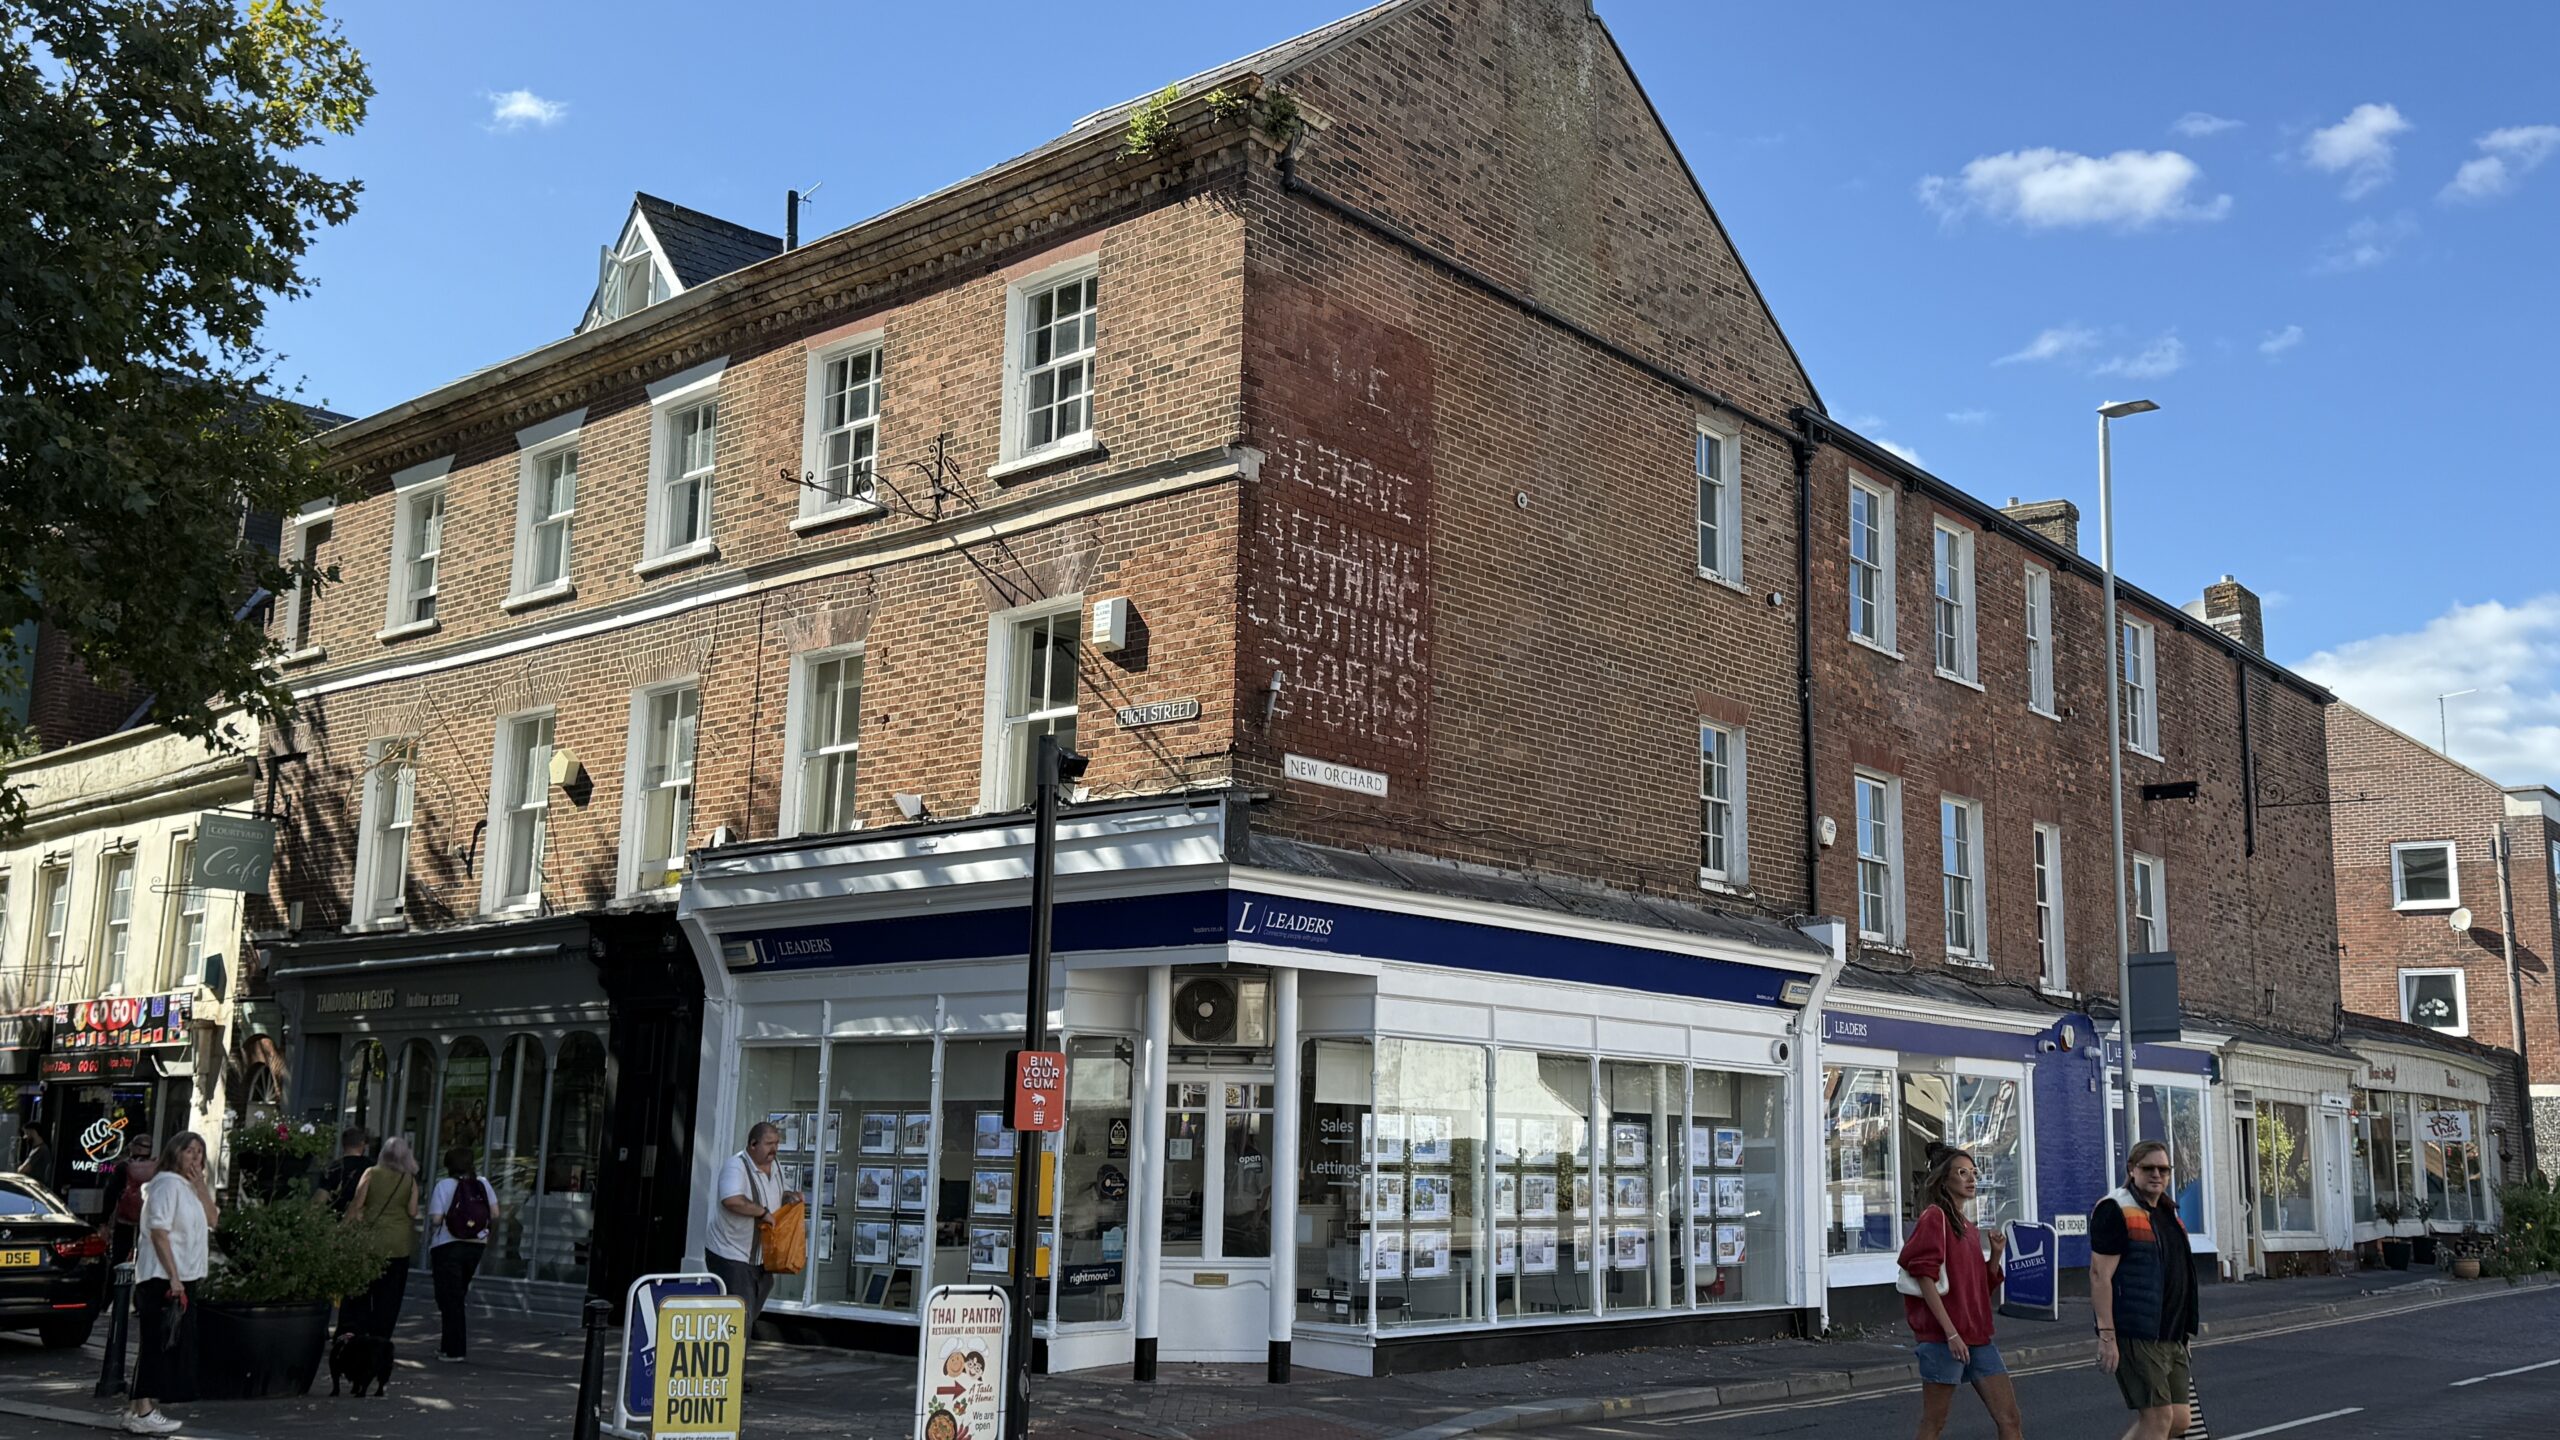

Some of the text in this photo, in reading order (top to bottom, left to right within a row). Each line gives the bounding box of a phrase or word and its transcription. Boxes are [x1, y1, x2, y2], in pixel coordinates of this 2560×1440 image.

[1120, 702, 1192, 725] HIGH STREET
[1290, 759, 1383, 791] NEW ORCHARD
[211, 826, 263, 840] COURTYARD
[1235, 901, 1334, 935] L LEADERS
[778, 938, 832, 955] LEADERS
[316, 991, 360, 1013] TANDOORI
[360, 987, 395, 1010] NIGHTS
[89, 999, 130, 1026] GO GO
[1835, 1021, 1868, 1037] LEADERS
[1030, 1056, 1053, 1067] BIN
[1023, 1067, 1060, 1078] YOUR
[1023, 1078, 1057, 1089] GUM.
[1320, 1117, 1354, 1133] Sales
[2427, 1120, 2461, 1137] Thai
[71, 1160, 98, 1173] VAPE
[1238, 1154, 1261, 1164] open
[1310, 1160, 1362, 1178] Lettings
[6, 1252, 31, 1264] DSE
[2010, 1256, 2046, 1271] LEADERS
[1070, 1271, 1109, 1286] rightmove
[932, 1307, 1003, 1324] THAI PANTRY
[671, 1314, 731, 1341] CLICK
[931, 1326, 1002, 1336] RESTAURANT AND TAKEAWAY
[669, 1341, 730, 1378] AND
[668, 1378, 729, 1397] COLLECT
[968, 1383, 993, 1395] A Taste
[967, 1395, 974, 1405] of
[666, 1397, 728, 1425] POINT
[972, 1411, 994, 1421] We are
[975, 1422, 991, 1432] open
